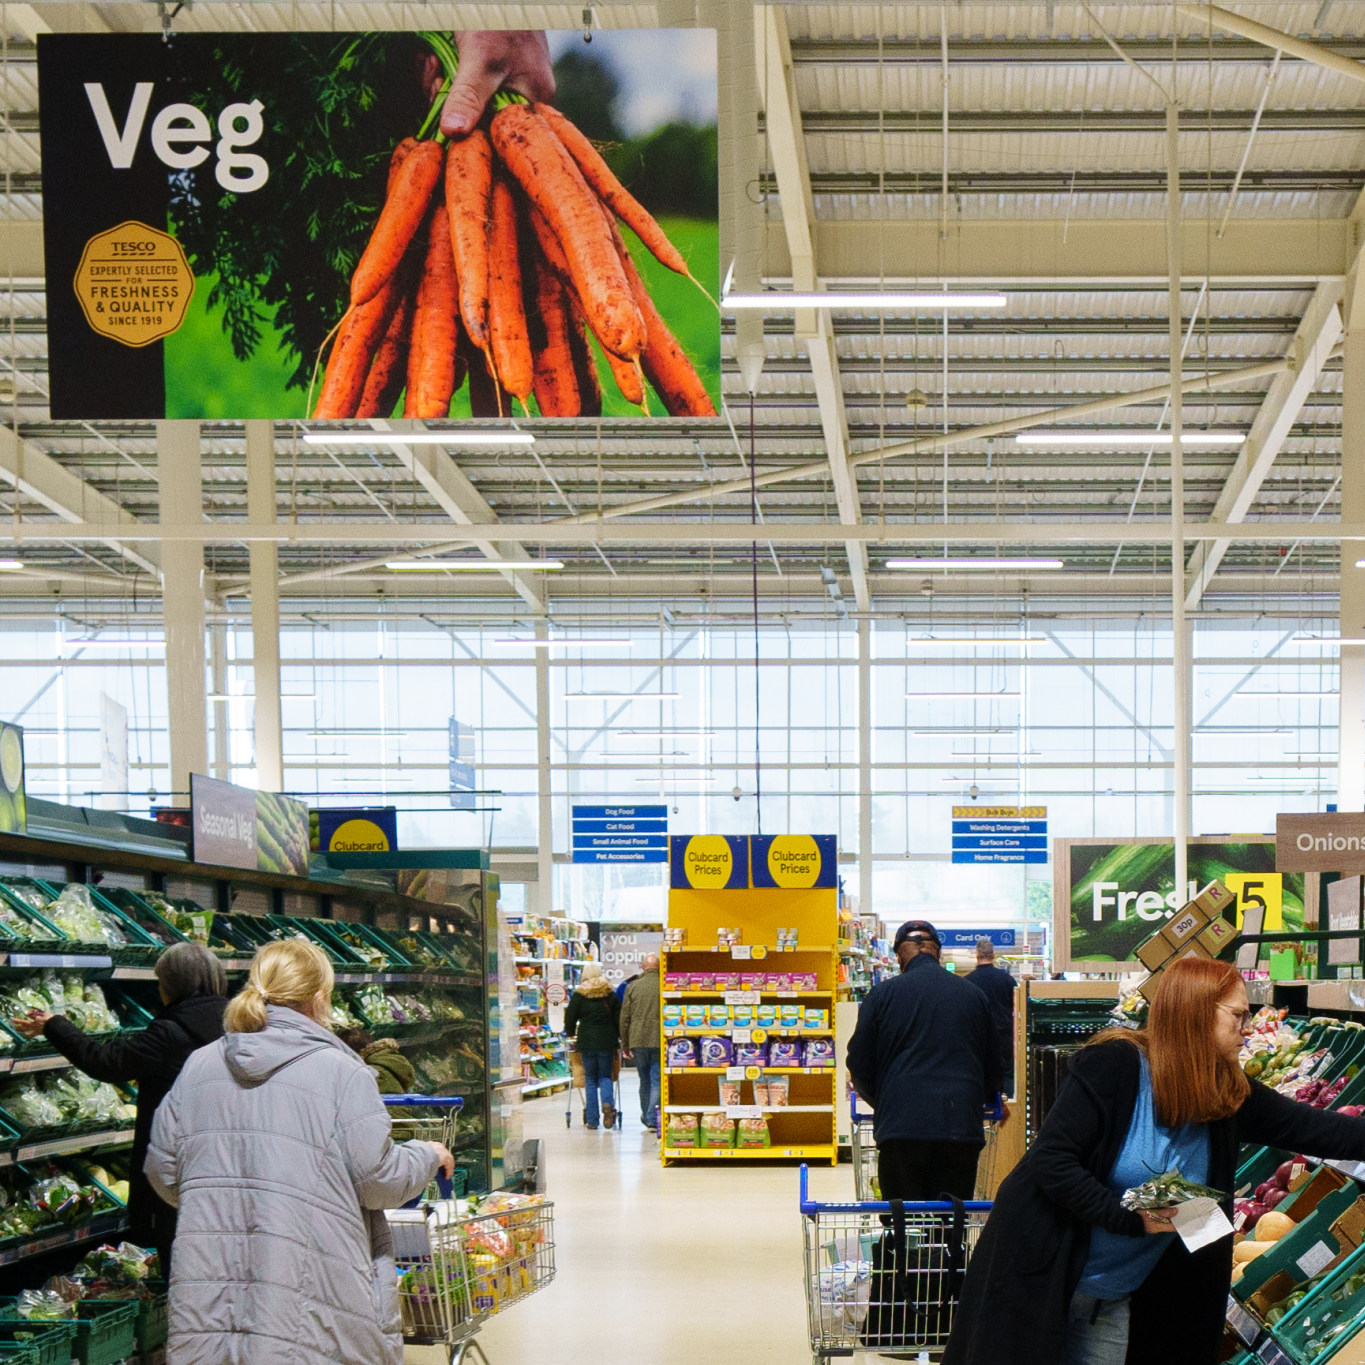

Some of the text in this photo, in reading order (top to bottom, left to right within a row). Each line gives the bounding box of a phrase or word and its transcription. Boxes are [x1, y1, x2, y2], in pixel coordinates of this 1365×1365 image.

[83, 82, 269, 193] Veg
[112, 242, 156, 251] TESCO
[90, 265, 178, 276] EXPERTLY SELECTED
[91, 286, 179, 298] FRESHNESS
[96, 301, 175, 313] & QUALITY
[109, 316, 162, 325] SINCE 1919
[604, 808, 635, 817] Dog Food
[200, 806, 252, 848] Seasonal Veg
[969, 824, 1030, 833] Washing Detergents
[334, 840, 384, 851] Clubcard
[688, 851, 728, 863] Clubcard
[772, 850, 817, 862] Clubcard
[994, 854, 1025, 862] Fragrance
[694, 864, 722, 876] Prices
[780, 862, 810, 874] Prices
[1176, 917, 1194, 933] 30p
[610, 934, 637, 946] you
